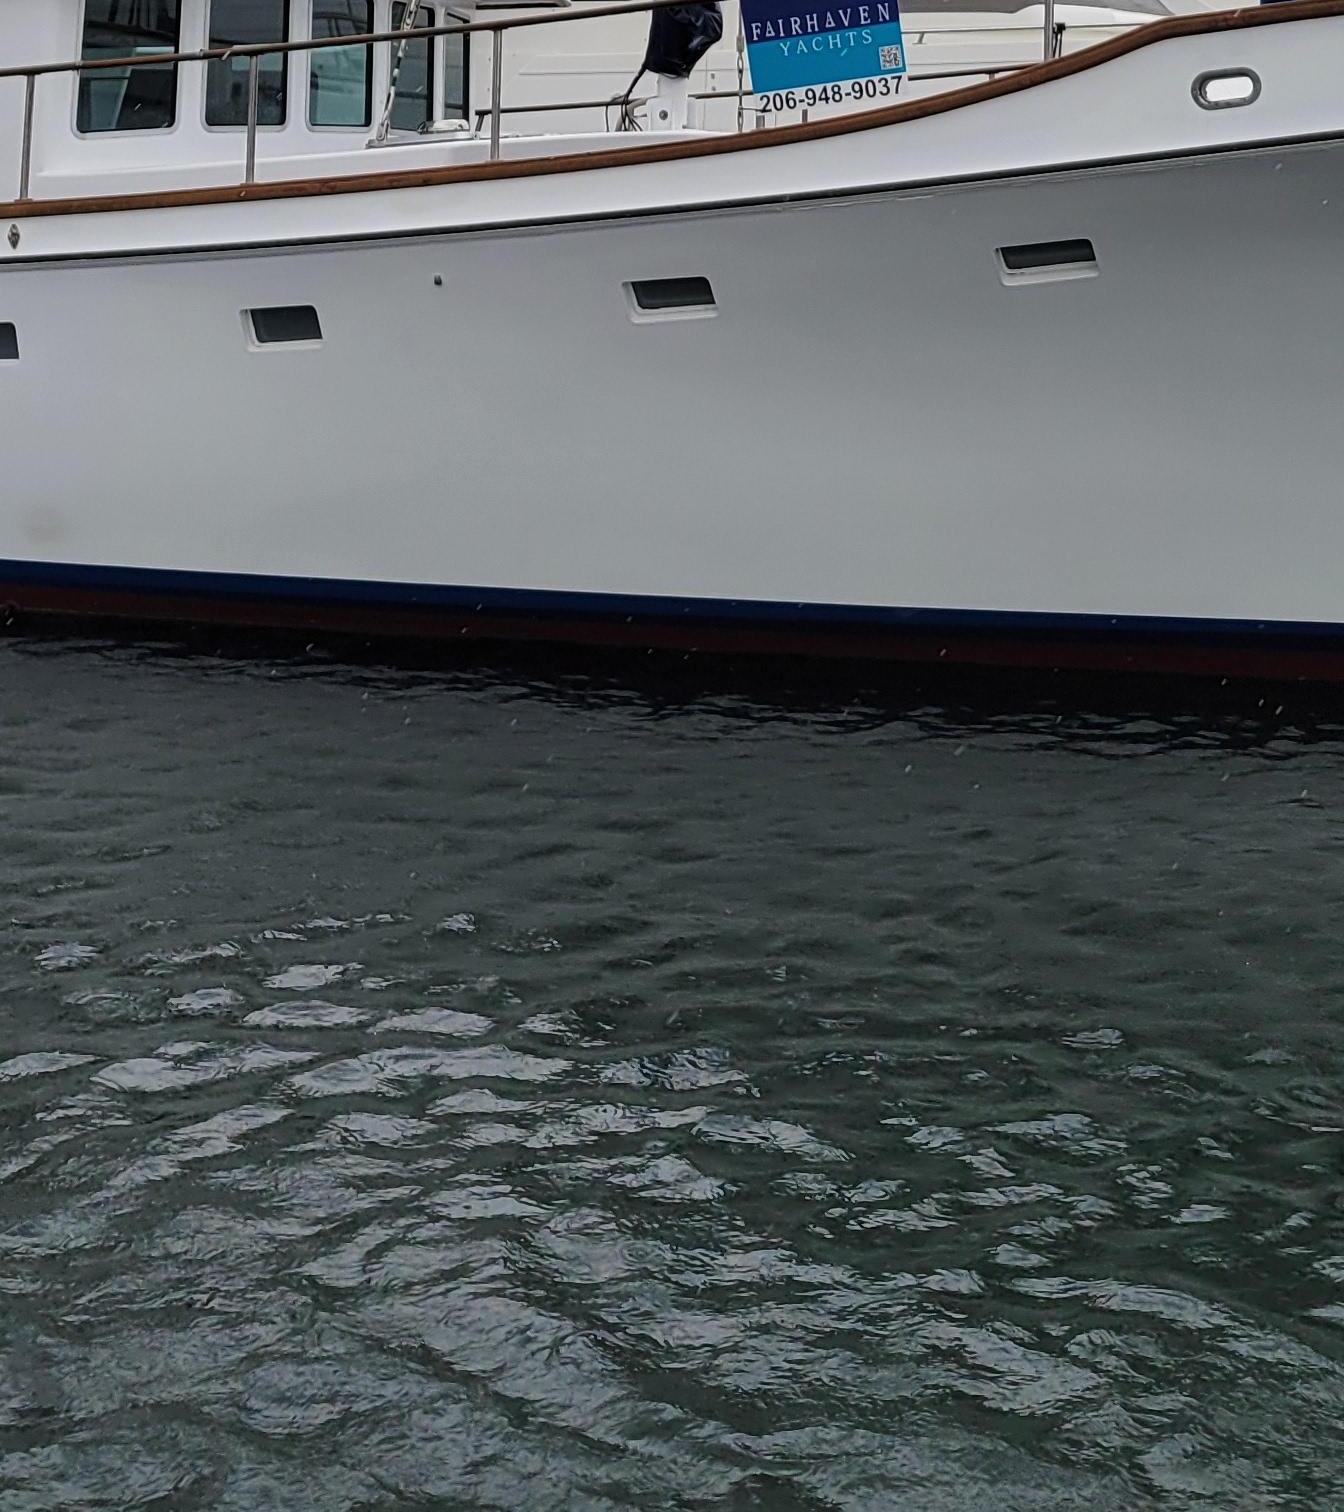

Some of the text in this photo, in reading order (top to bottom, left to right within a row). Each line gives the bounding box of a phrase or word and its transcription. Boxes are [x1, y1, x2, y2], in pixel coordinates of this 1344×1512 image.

[750, 2, 891, 42] FAIRHAVEN
[779, 29, 873, 57] YACHTS
[759, 74, 904, 114] 206-948-9037
